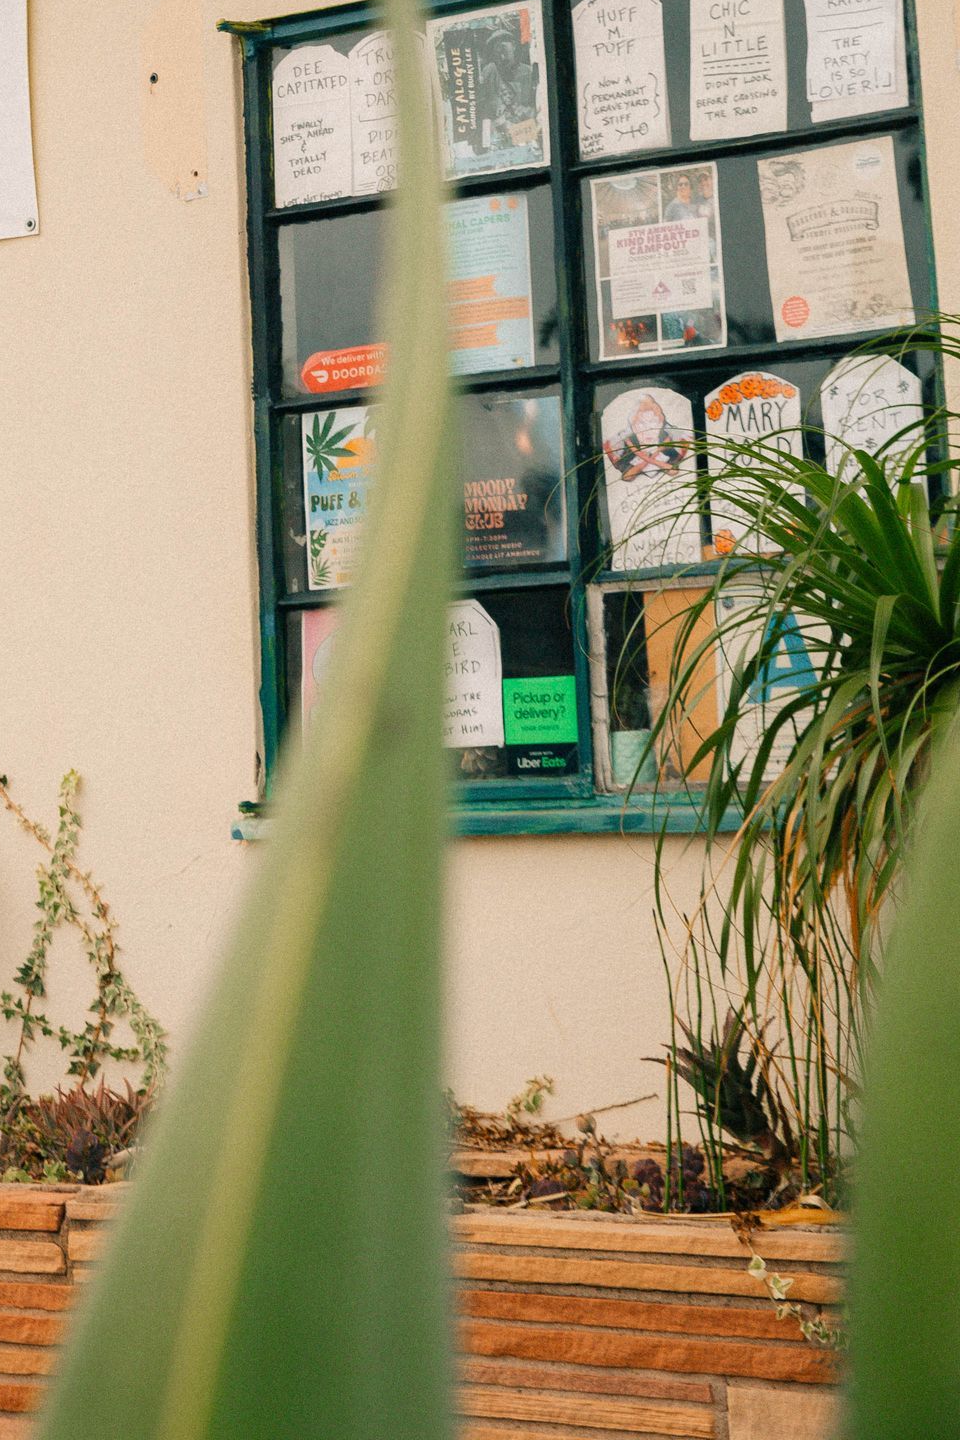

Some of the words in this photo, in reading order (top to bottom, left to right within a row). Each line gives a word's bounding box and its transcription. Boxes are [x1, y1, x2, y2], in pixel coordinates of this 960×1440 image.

[597, 7, 637, 26] HUFF
[709, 0, 751, 20] CHIC
[593, 39, 636, 57] PUFF
[701, 35, 769, 57] LITTLE
[832, 35, 862, 50] THE
[293, 60, 323, 78] DEE
[824, 50, 871, 70] PARTY
[277, 75, 348, 99] CAPITATED
[592, 86, 647, 105] PERMANENT
[696, 94, 728, 108] BEFORE
[602, 113, 633, 127] STIFF
[704, 110, 727, 121] THE
[291, 118, 324, 132] FINALLY
[289, 151, 327, 168] TOTALLY
[293, 165, 322, 179] DEAD
[616, 236, 644, 249] KIND
[647, 229, 700, 243] HEARTED
[629, 239, 688, 255] CAMPOUT
[321, 357, 336, 366] We
[337, 352, 365, 365] deliver
[366, 350, 385, 361] with
[726, 400, 788, 433] MARY
[463, 478, 516, 498] MOODY
[310, 494, 344, 513] PUFF
[348, 490, 361, 509] &
[464, 493, 529, 514] MONDAY
[464, 512, 505, 531] CLUB
[449, 620, 479, 637] ARL
[746, 611, 819, 704] A
[513, 692, 552, 705] Pickup
[553, 692, 566, 703] or
[514, 706, 566, 720] delivery?
[517, 756, 541, 769] Uber
[542, 756, 567, 768] Eats
